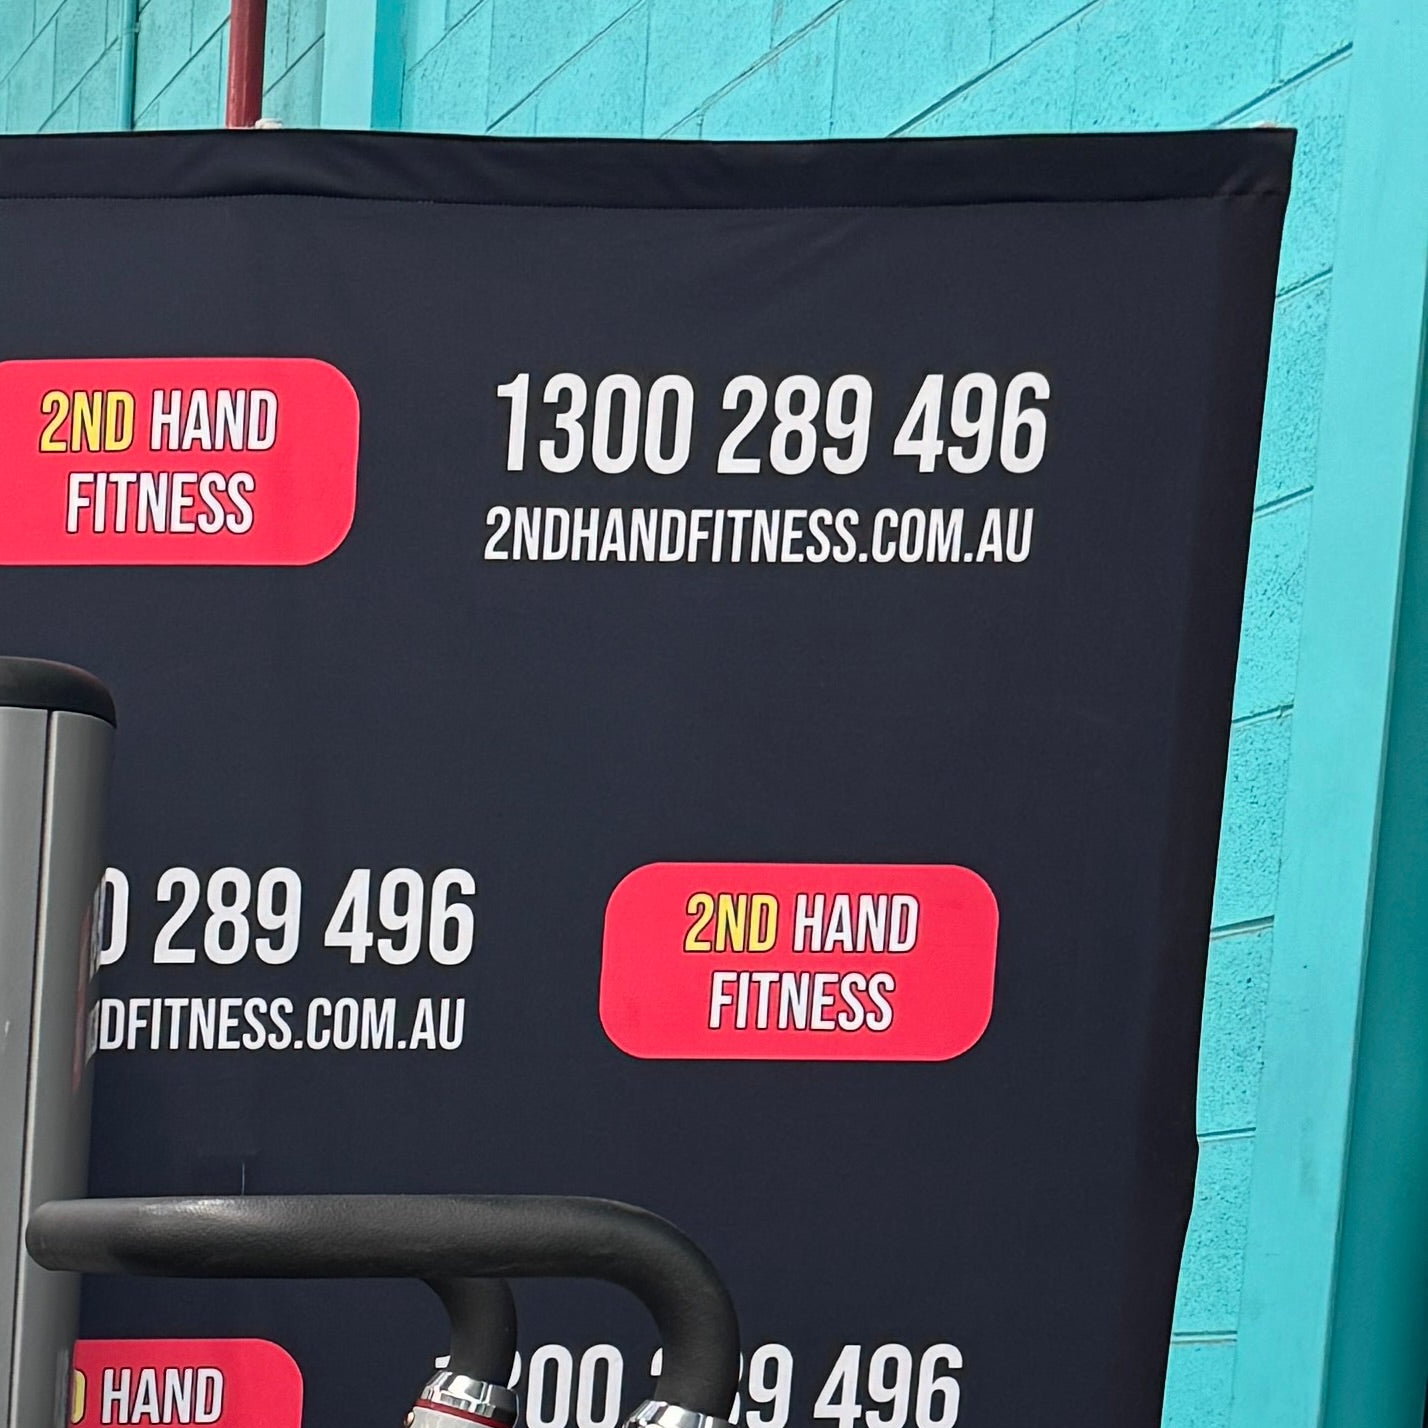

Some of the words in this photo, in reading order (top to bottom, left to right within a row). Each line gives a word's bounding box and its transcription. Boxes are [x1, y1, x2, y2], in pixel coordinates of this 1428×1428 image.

[40, 390, 134, 452] 2ND
[151, 389, 278, 450] HAND
[497, 372, 695, 475] 1300
[716, 374, 873, 475] 289
[893, 371, 1051, 474] 496
[67, 472, 255, 534] FITNESS
[484, 505, 1034, 563] 2NDHANDFITNESS.COM.AU
[153, 866, 302, 965] 289
[324, 867, 476, 966] 496
[685, 893, 778, 952] 2ND
[793, 894, 919, 952] HAND
[99, 997, 466, 1051] DFITNESS.COM.AU
[709, 971, 895, 1031] FITNESS
[102, 1368, 224, 1424] HAND
